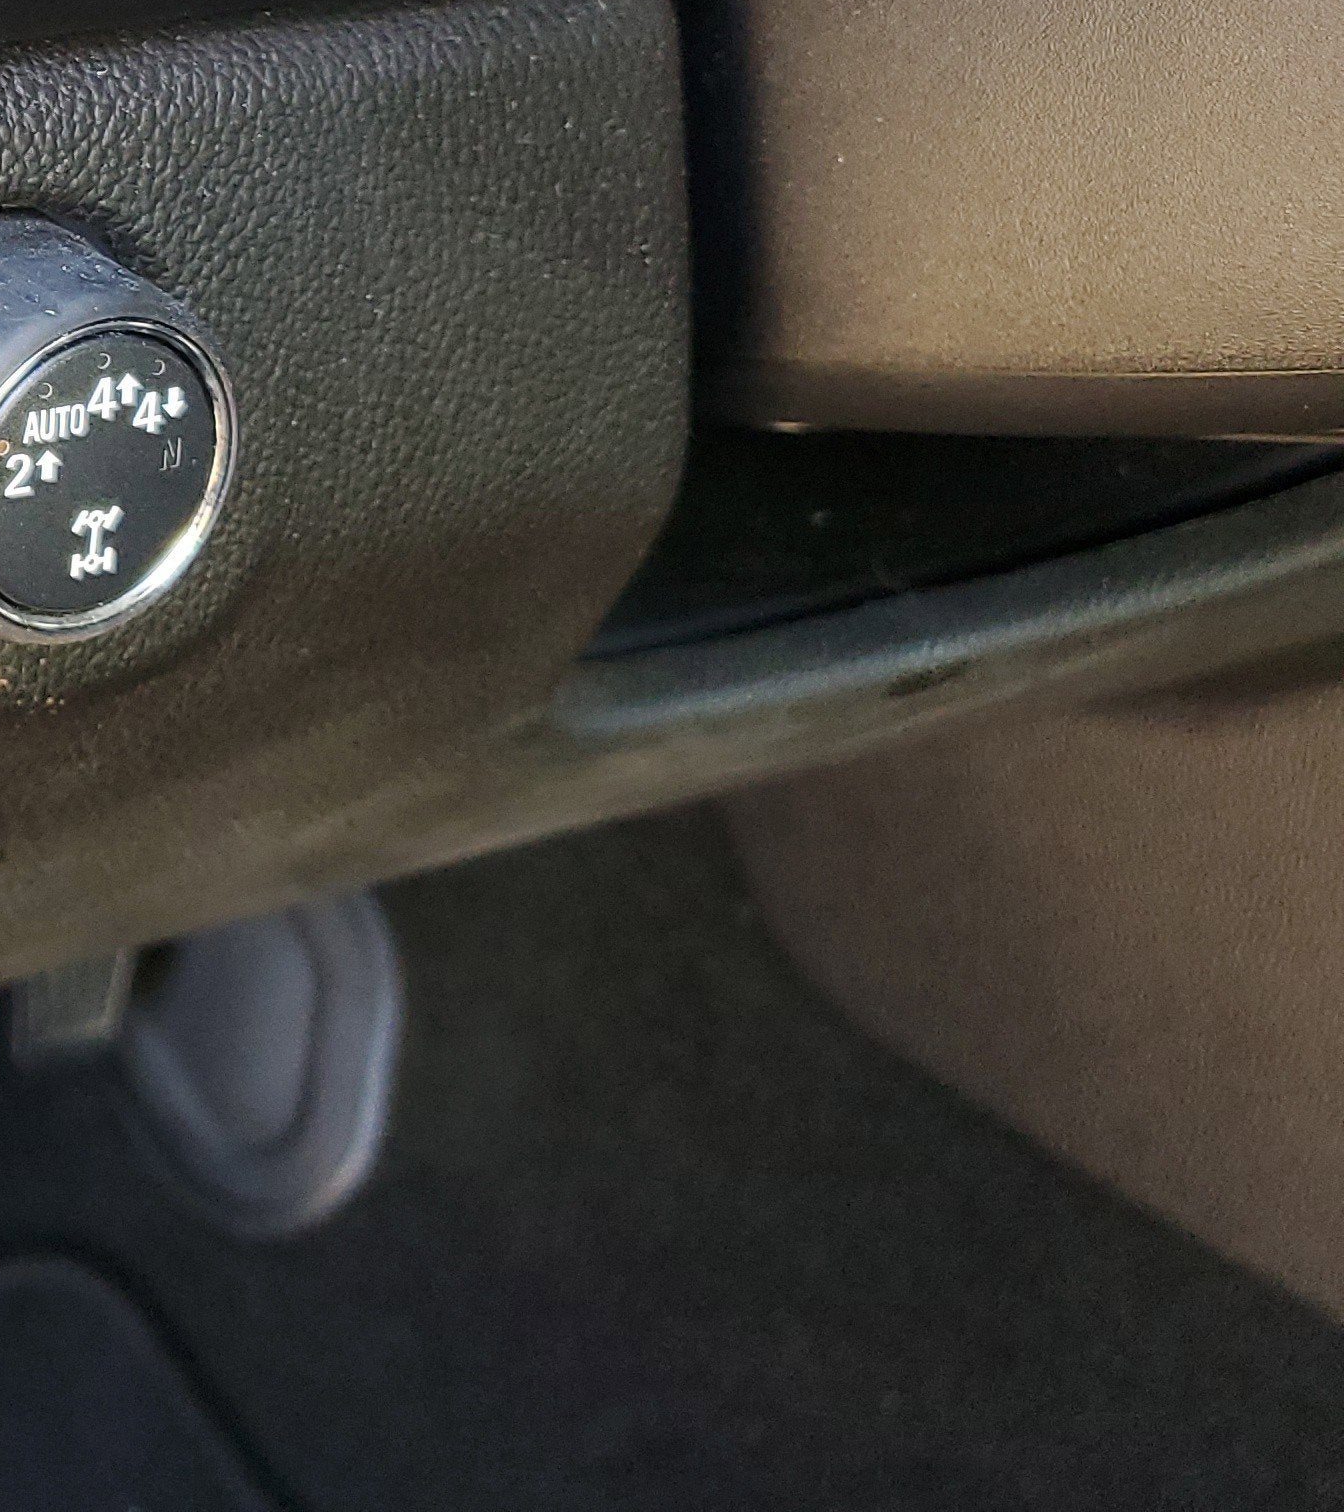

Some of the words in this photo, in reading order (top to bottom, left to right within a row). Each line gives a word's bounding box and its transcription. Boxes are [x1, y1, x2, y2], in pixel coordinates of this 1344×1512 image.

[86, 376, 120, 421] 4
[132, 391, 164, 434] 4
[22, 403, 89, 445] AUTO
[3, 453, 36, 498] 2
